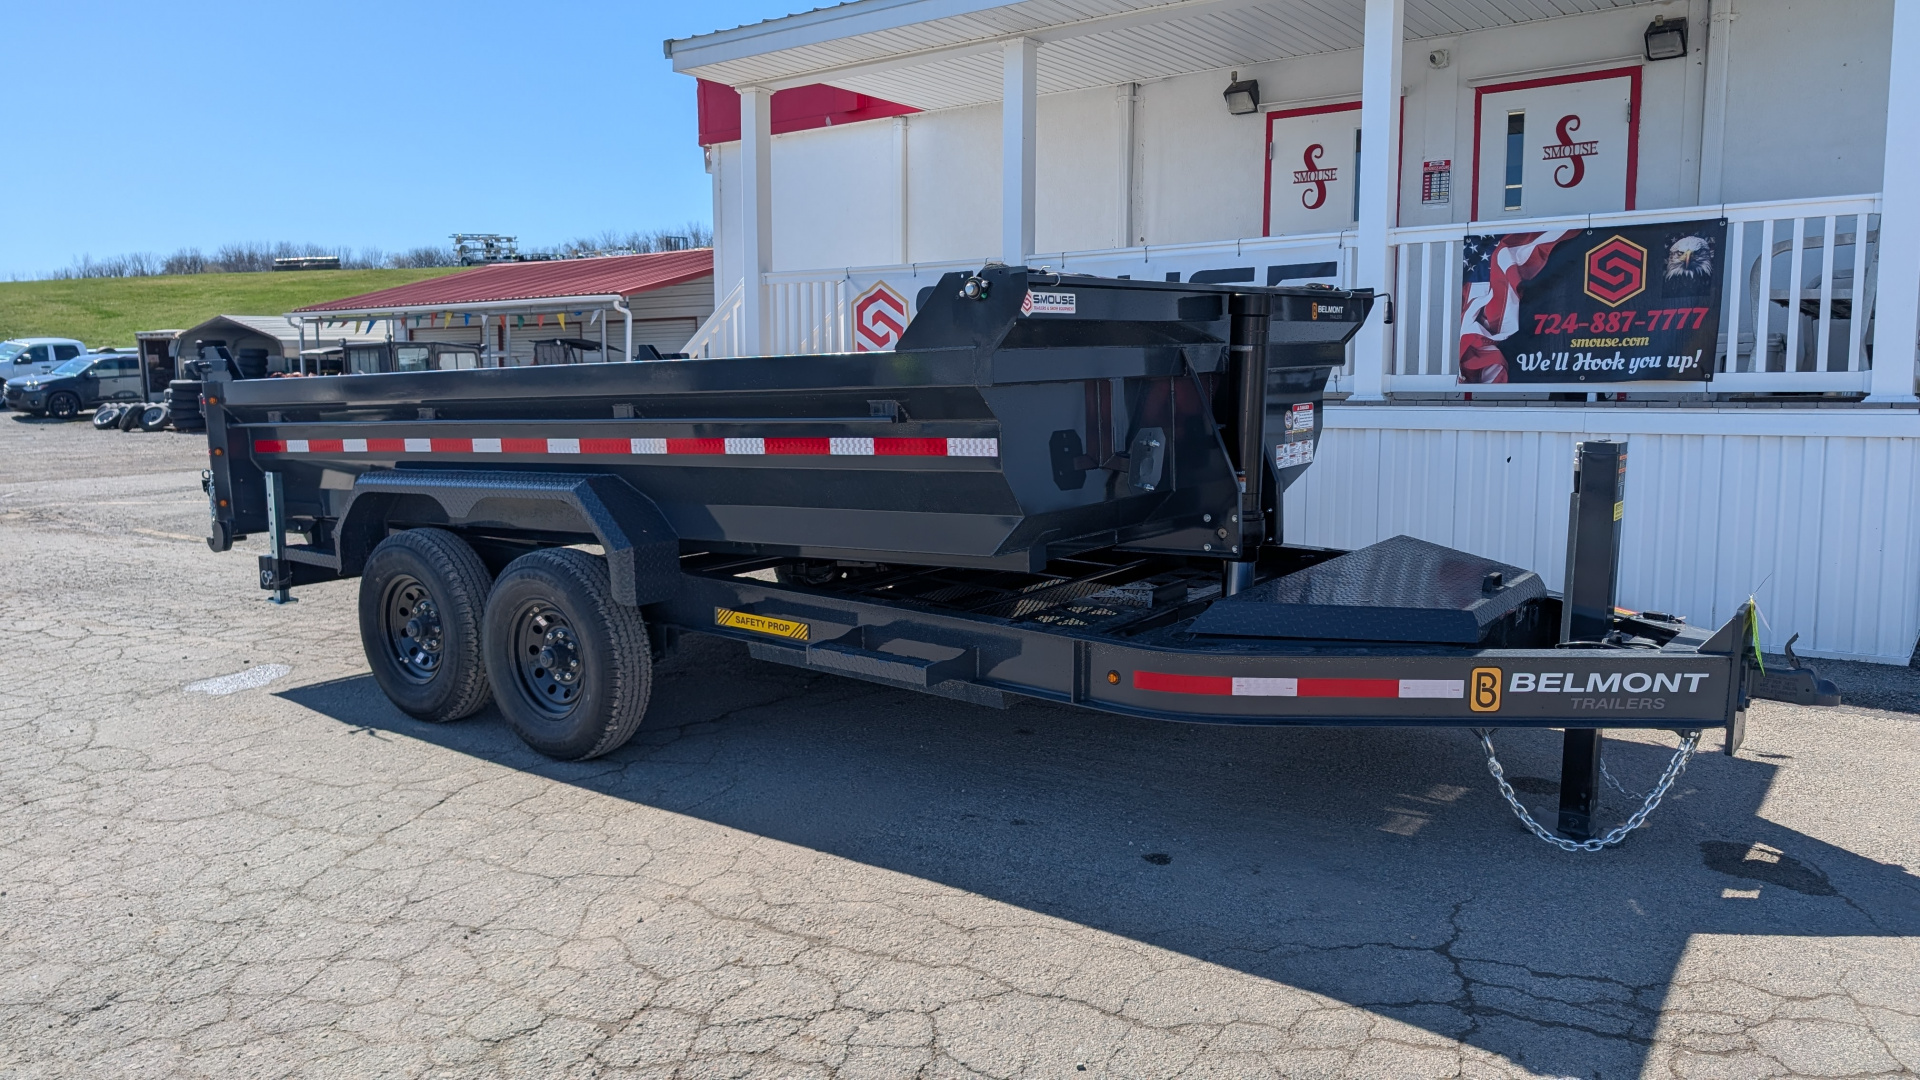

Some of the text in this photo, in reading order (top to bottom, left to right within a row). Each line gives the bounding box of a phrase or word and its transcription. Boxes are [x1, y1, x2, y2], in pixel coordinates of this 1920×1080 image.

[1543, 141, 1598, 160] SMOUSE
[1292, 168, 1338, 184] SMOUSE
[1033, 294, 1074, 304] SMOUSE
[1318, 305, 1344, 314] BELMONT
[1534, 307, 1709, 335] 724-887-7777
[1570, 336, 1649, 348] smouse.com
[1516, 349, 1703, 374] We'll Hook you up!
[735, 615, 791, 632] SAFETY PROP
[1509, 672, 1710, 693] BELMONT
[1571, 697, 1666, 710] TRAILERS
